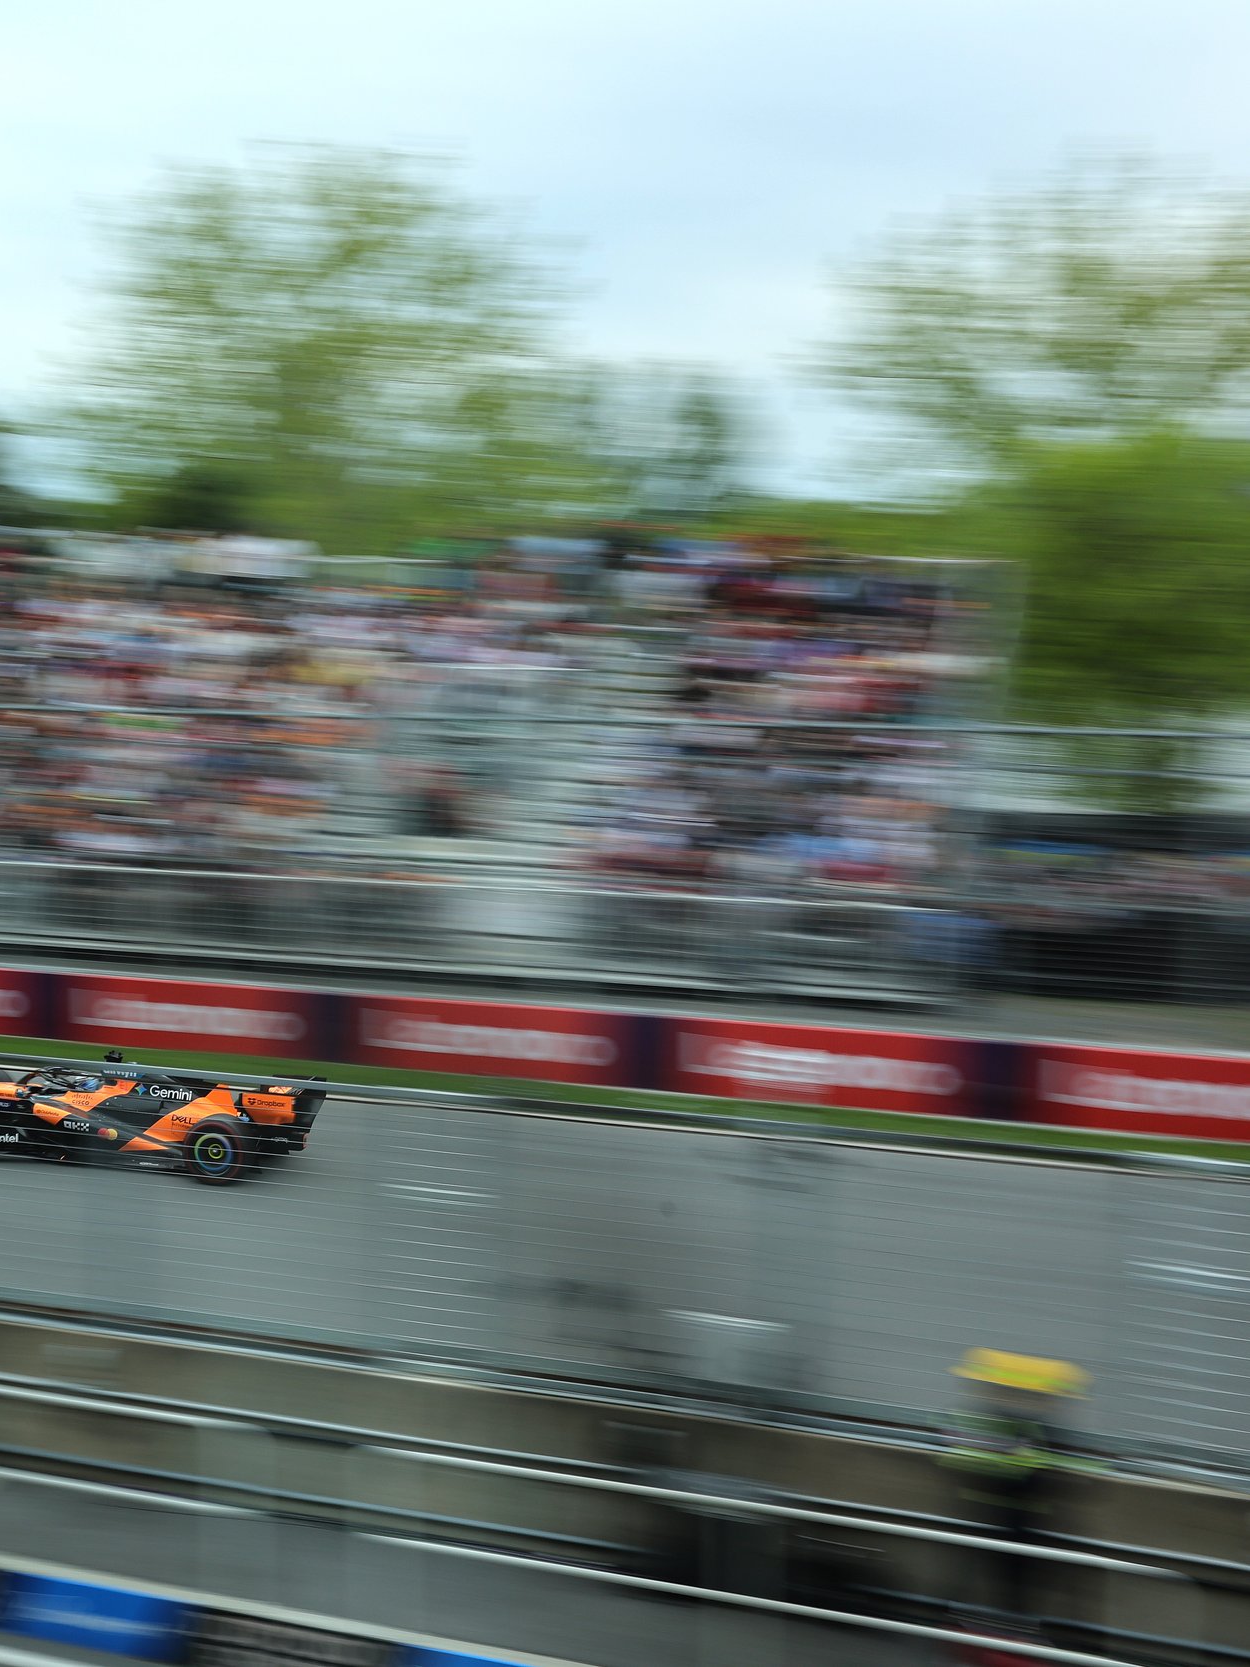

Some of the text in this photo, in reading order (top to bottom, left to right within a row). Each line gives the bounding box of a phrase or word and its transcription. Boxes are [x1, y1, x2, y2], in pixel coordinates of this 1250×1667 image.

[150, 1085, 192, 1101] Gemini
[256, 1099, 286, 1108] Dropbox
[171, 1114, 196, 1125] DELL
[63, 1120, 90, 1132] OKX
